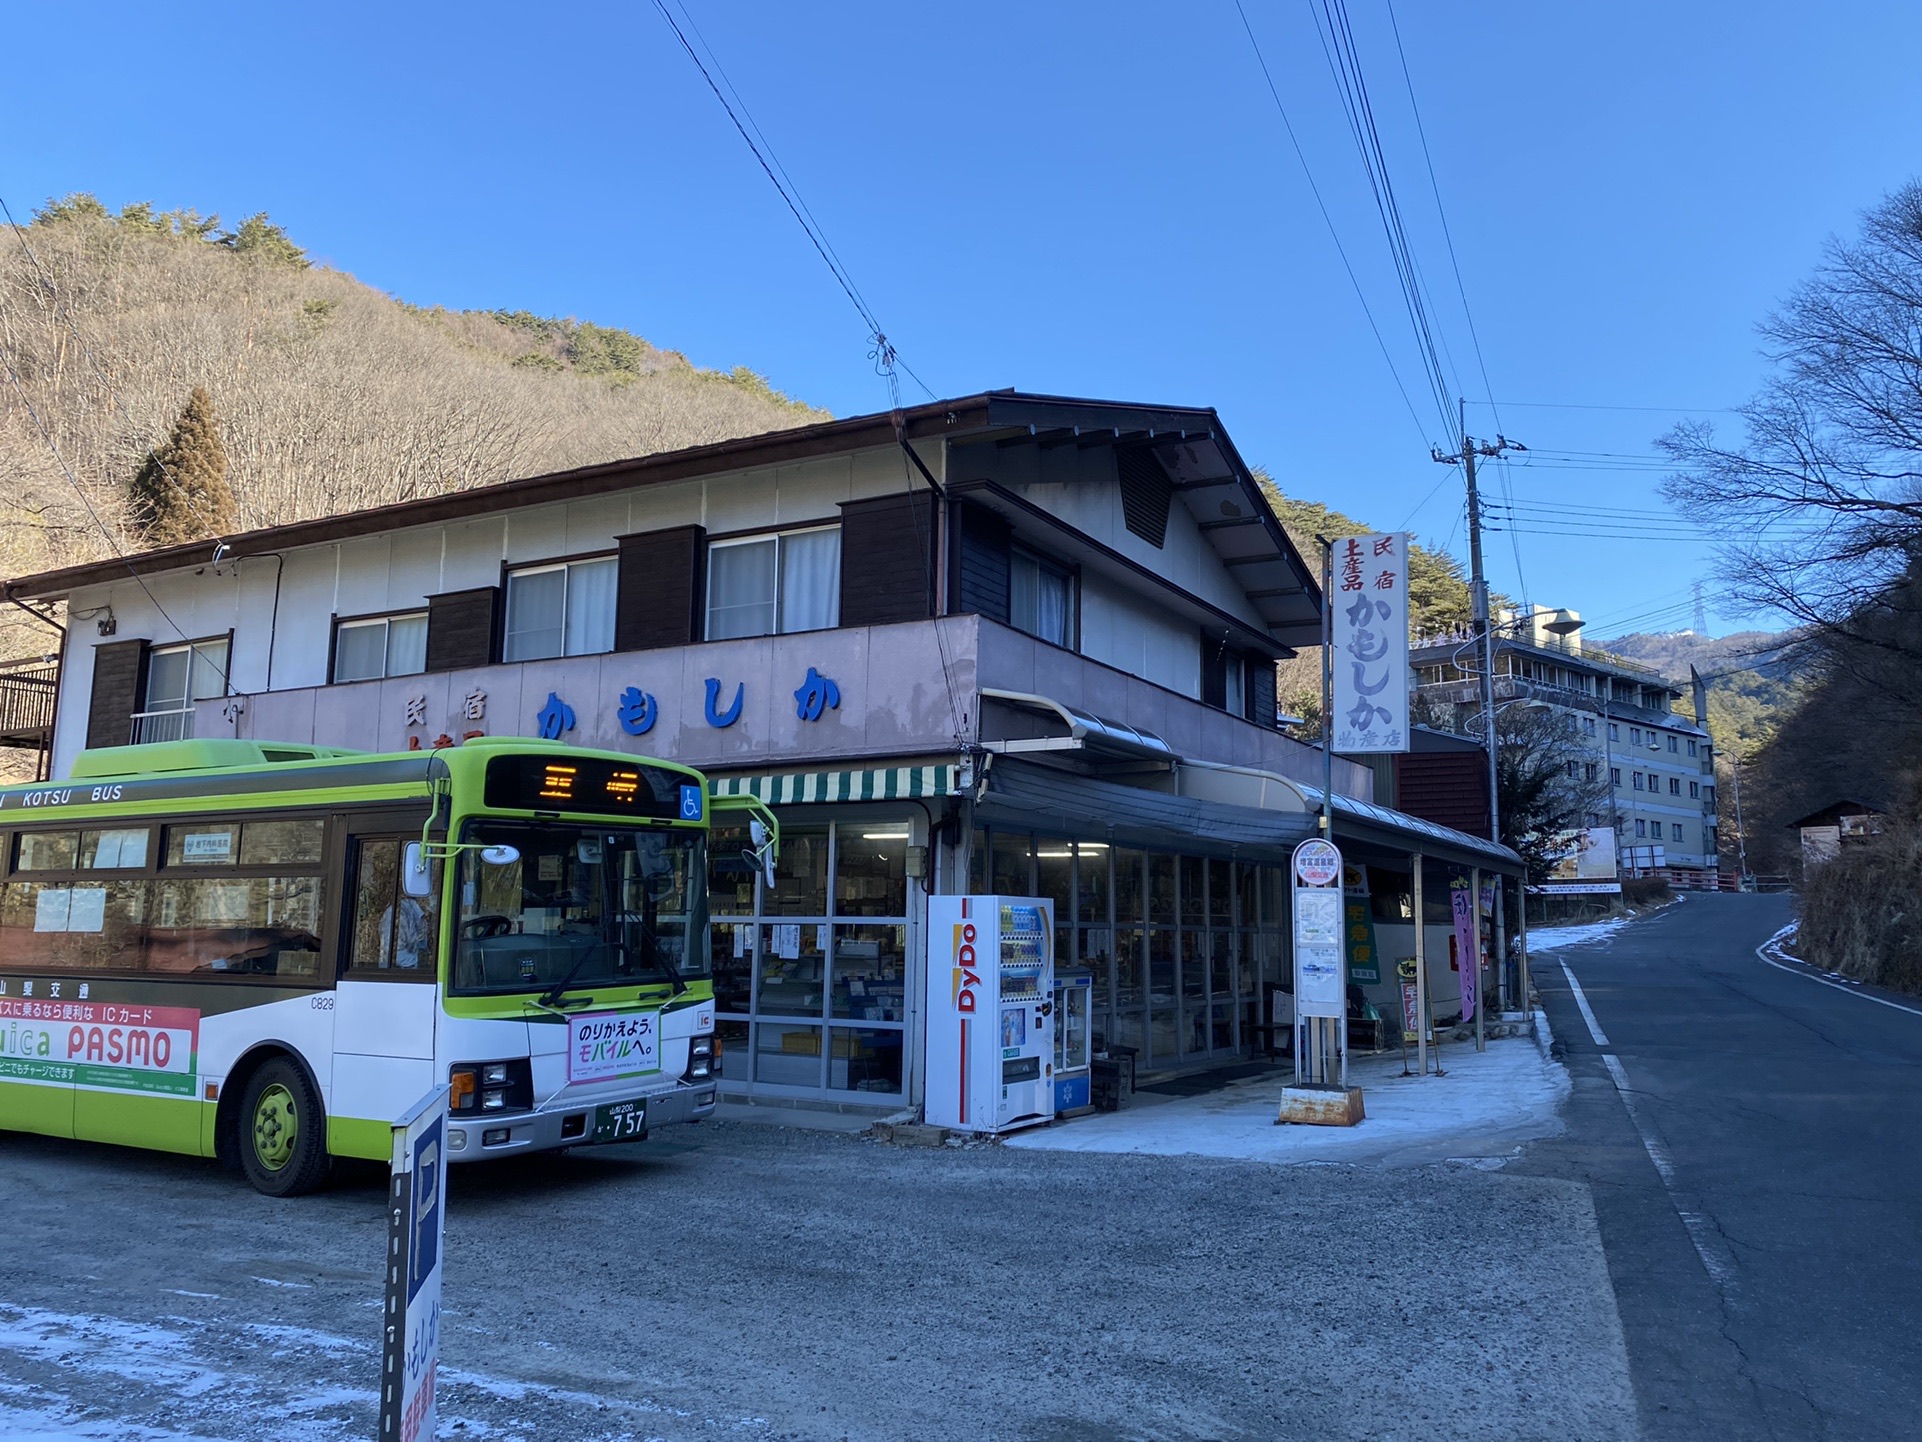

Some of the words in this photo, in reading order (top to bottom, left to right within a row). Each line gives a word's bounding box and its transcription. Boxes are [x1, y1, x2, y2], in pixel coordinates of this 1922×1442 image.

[1341, 538, 1365, 592] 土産品
[1372, 536, 1397, 591] 民宿
[1346, 592, 1393, 732] かもしか
[537, 667, 841, 740] かもしか
[22, 789, 72, 807] KOTSU
[91, 785, 123, 801] BUS
[958, 923, 981, 1013] DyDo
[311, 997, 334, 1010] C829
[67, 1025, 171, 1068] PASMO
